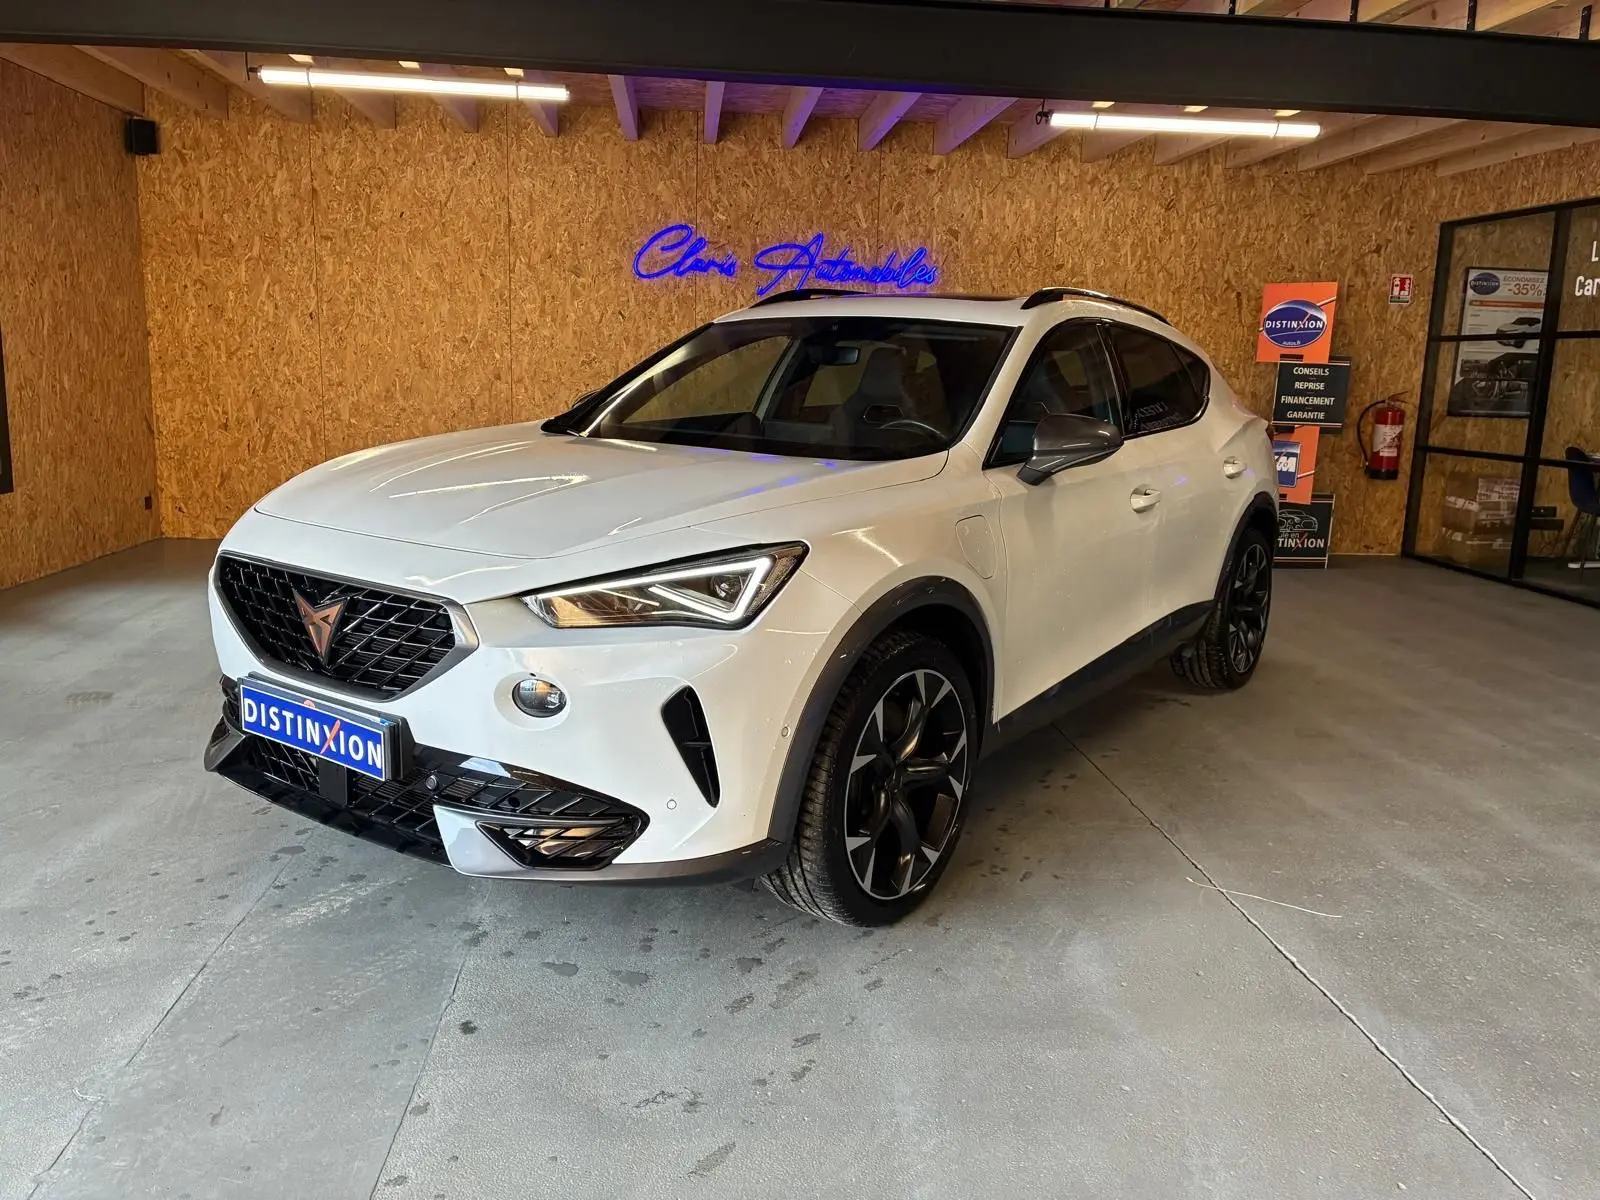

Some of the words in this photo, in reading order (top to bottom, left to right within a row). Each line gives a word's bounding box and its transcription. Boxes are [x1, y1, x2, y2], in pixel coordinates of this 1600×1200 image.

[754, 231, 938, 297] Automobiles
[1265, 320, 1323, 330] DISTINXION
[1293, 366, 1330, 376] CONSEILS
[1294, 381, 1325, 390] REPRISE
[1280, 395, 1335, 406] FINANCEMENT
[1286, 410, 1326, 420] GARANTIE
[1277, 537, 1325, 549] TINXION
[243, 698, 382, 770] DISTINXION
